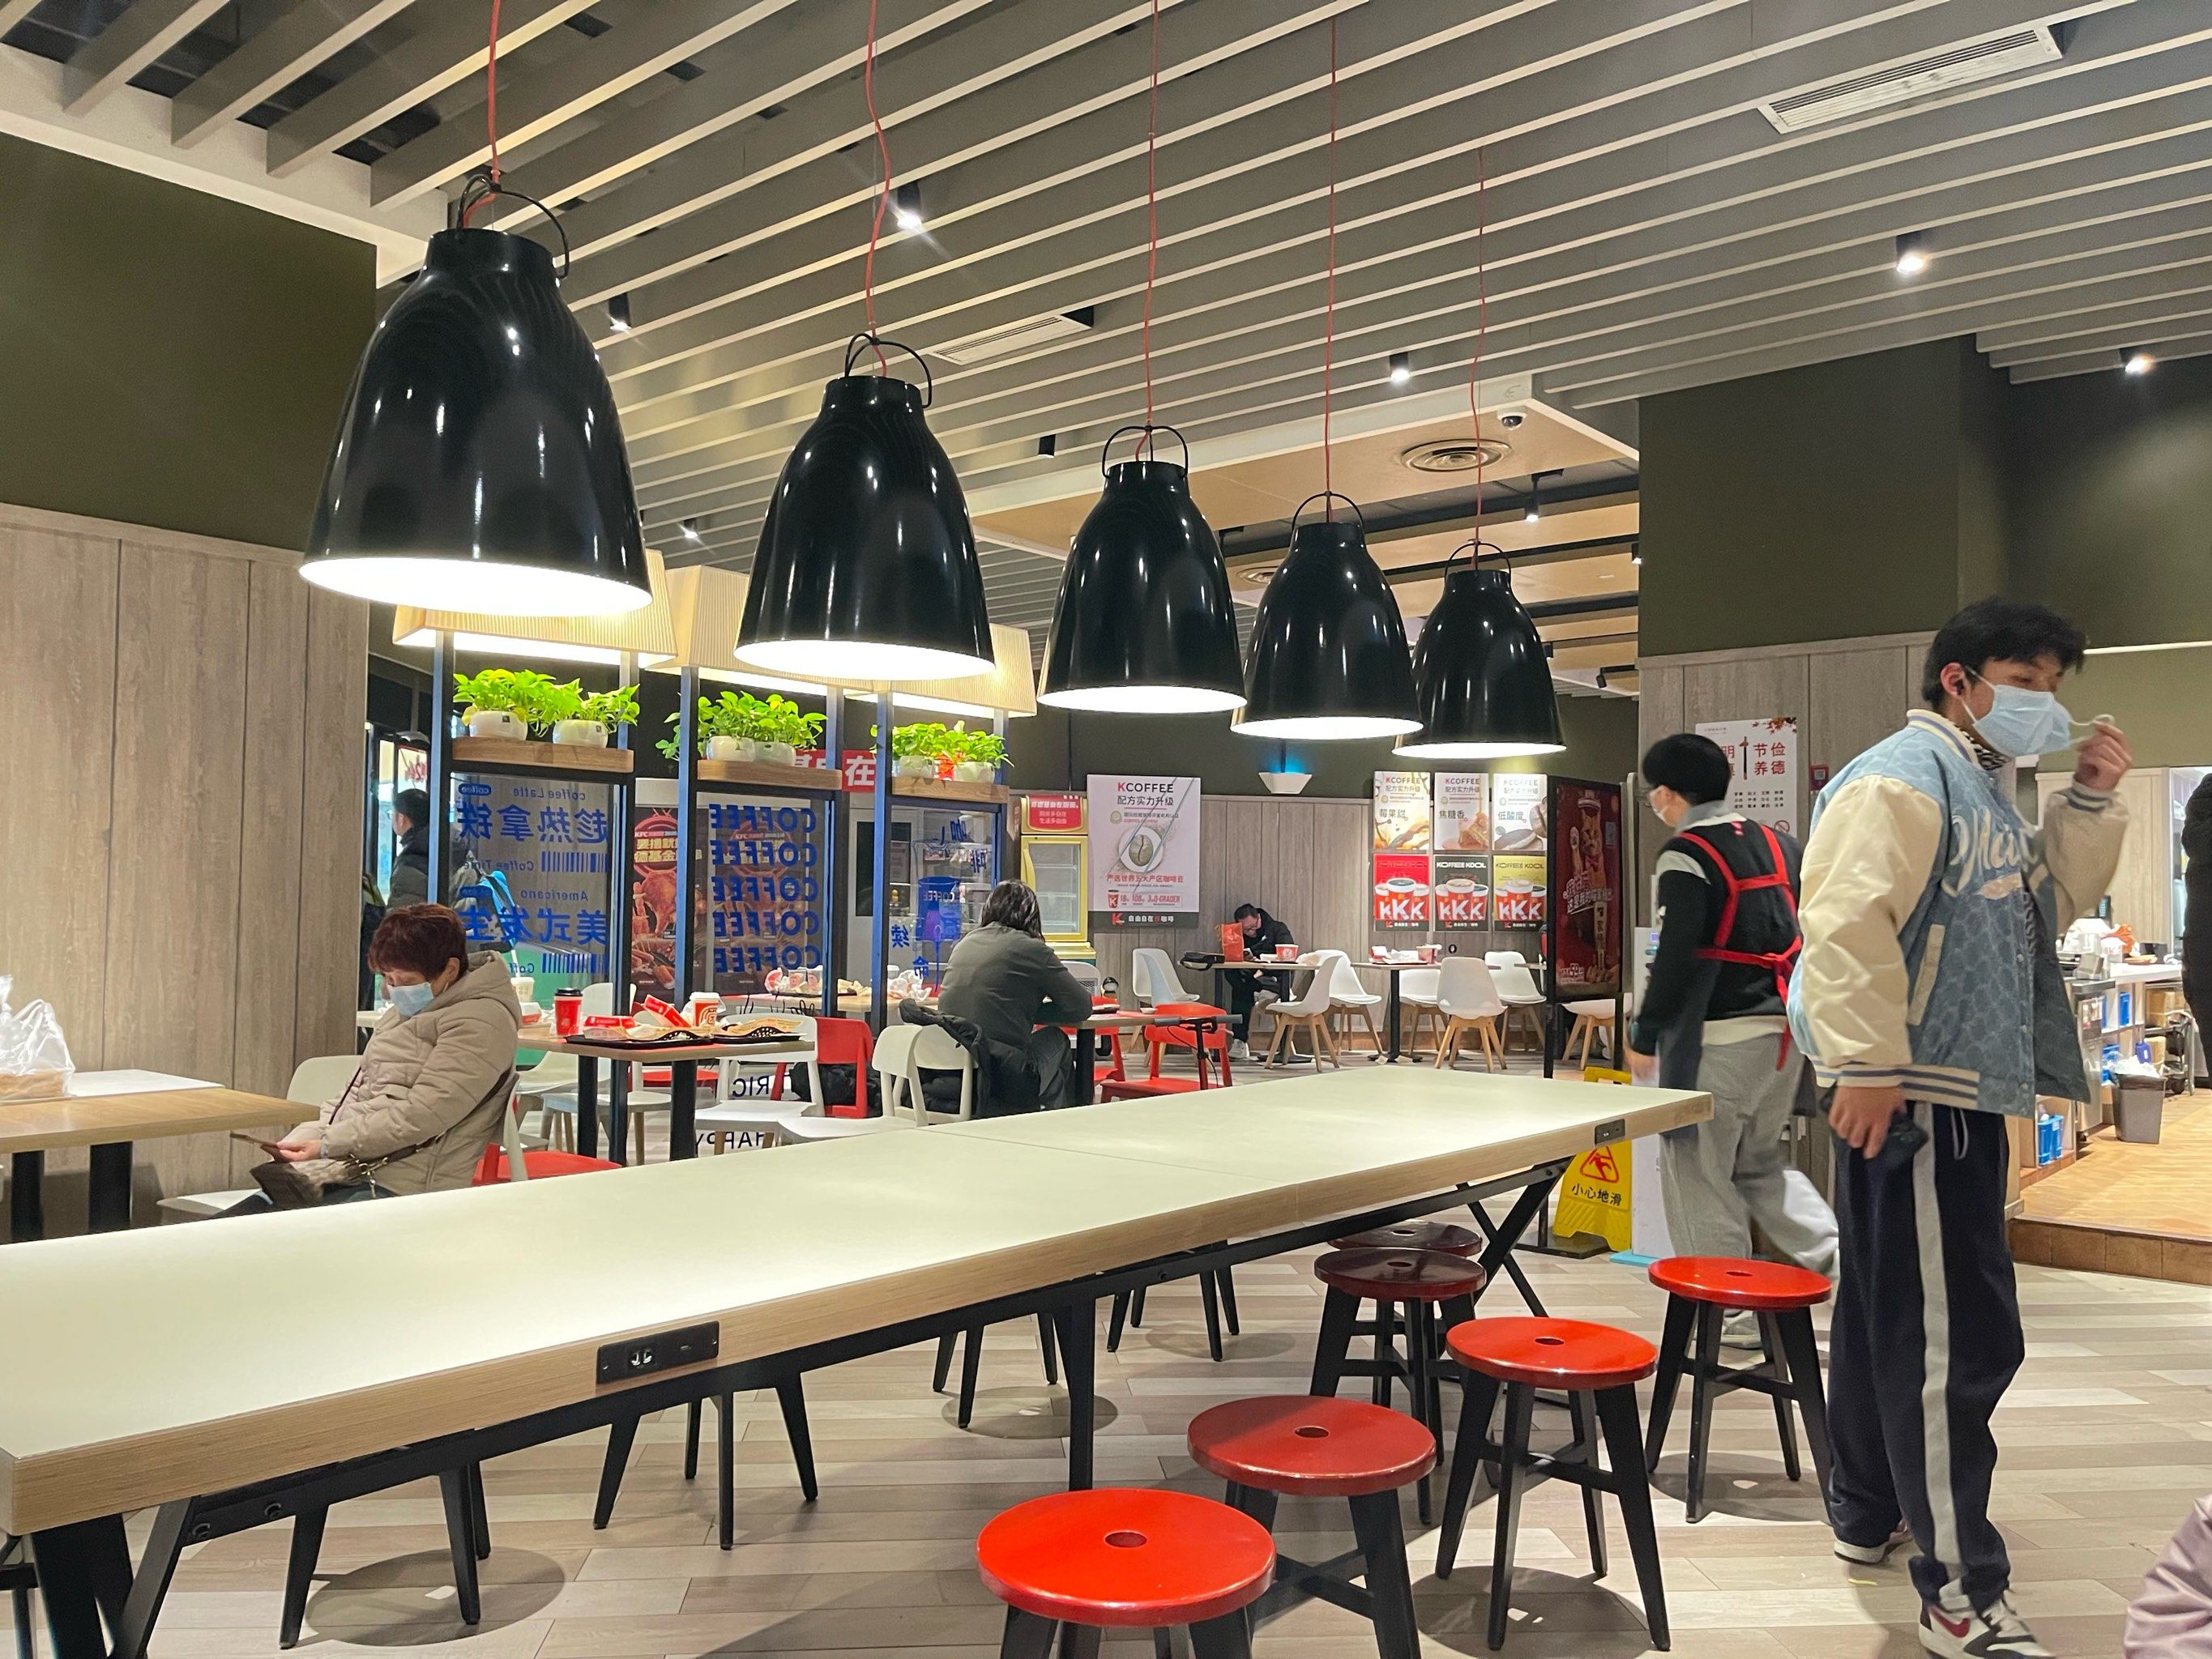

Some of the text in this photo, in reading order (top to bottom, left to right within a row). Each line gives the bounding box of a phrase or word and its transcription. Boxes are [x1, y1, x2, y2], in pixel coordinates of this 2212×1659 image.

[1753, 742, 1786, 757] 节俭
[1753, 761, 1785, 776] 养德
[1117, 783, 1174, 793] KCOFFEE
[1117, 795, 1173, 806] 配方实力升级
[1439, 809, 1465, 819] 焦糖香
[1571, 1183, 1622, 1206] 小心地滑
